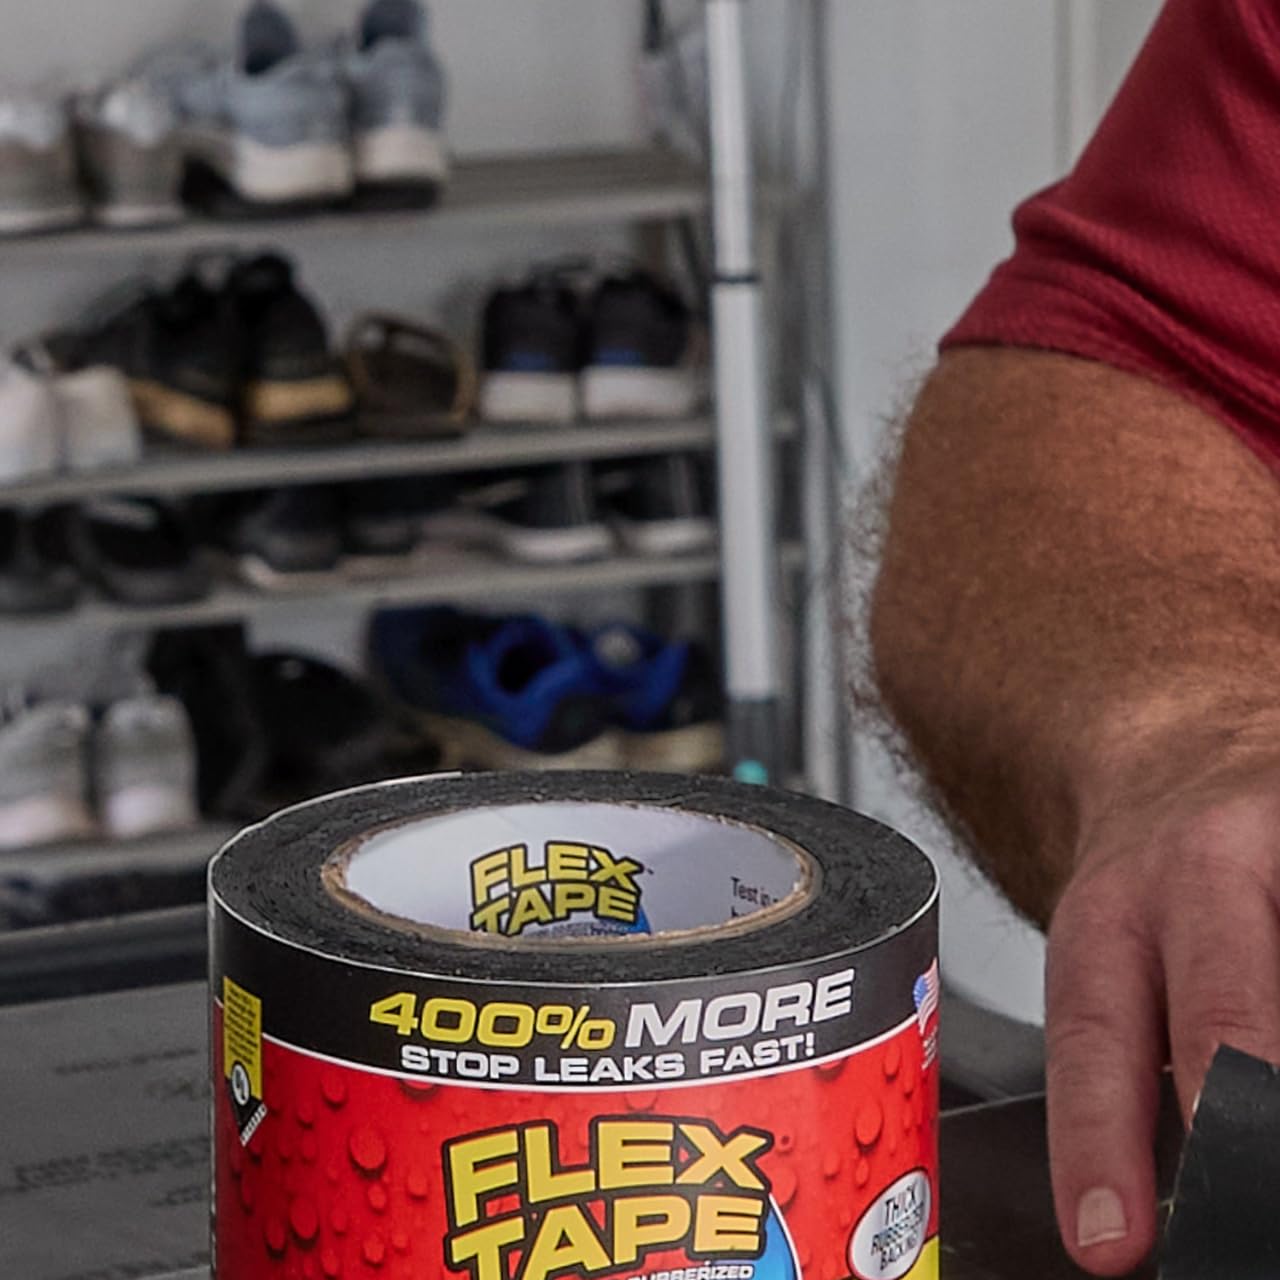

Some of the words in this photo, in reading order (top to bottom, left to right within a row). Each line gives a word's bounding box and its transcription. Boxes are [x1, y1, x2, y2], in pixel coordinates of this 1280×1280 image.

[470, 841, 645, 905] FLEX
[730, 876, 758, 905] Test
[470, 881, 640, 937] TAPE
[369, 992, 618, 1050] 400%
[624, 968, 855, 1049] MORE
[401, 1045, 520, 1079] STOP
[534, 1056, 687, 1083] LEAKS
[700, 1032, 815, 1075] FAST!
[447, 1119, 771, 1229] FLEX
